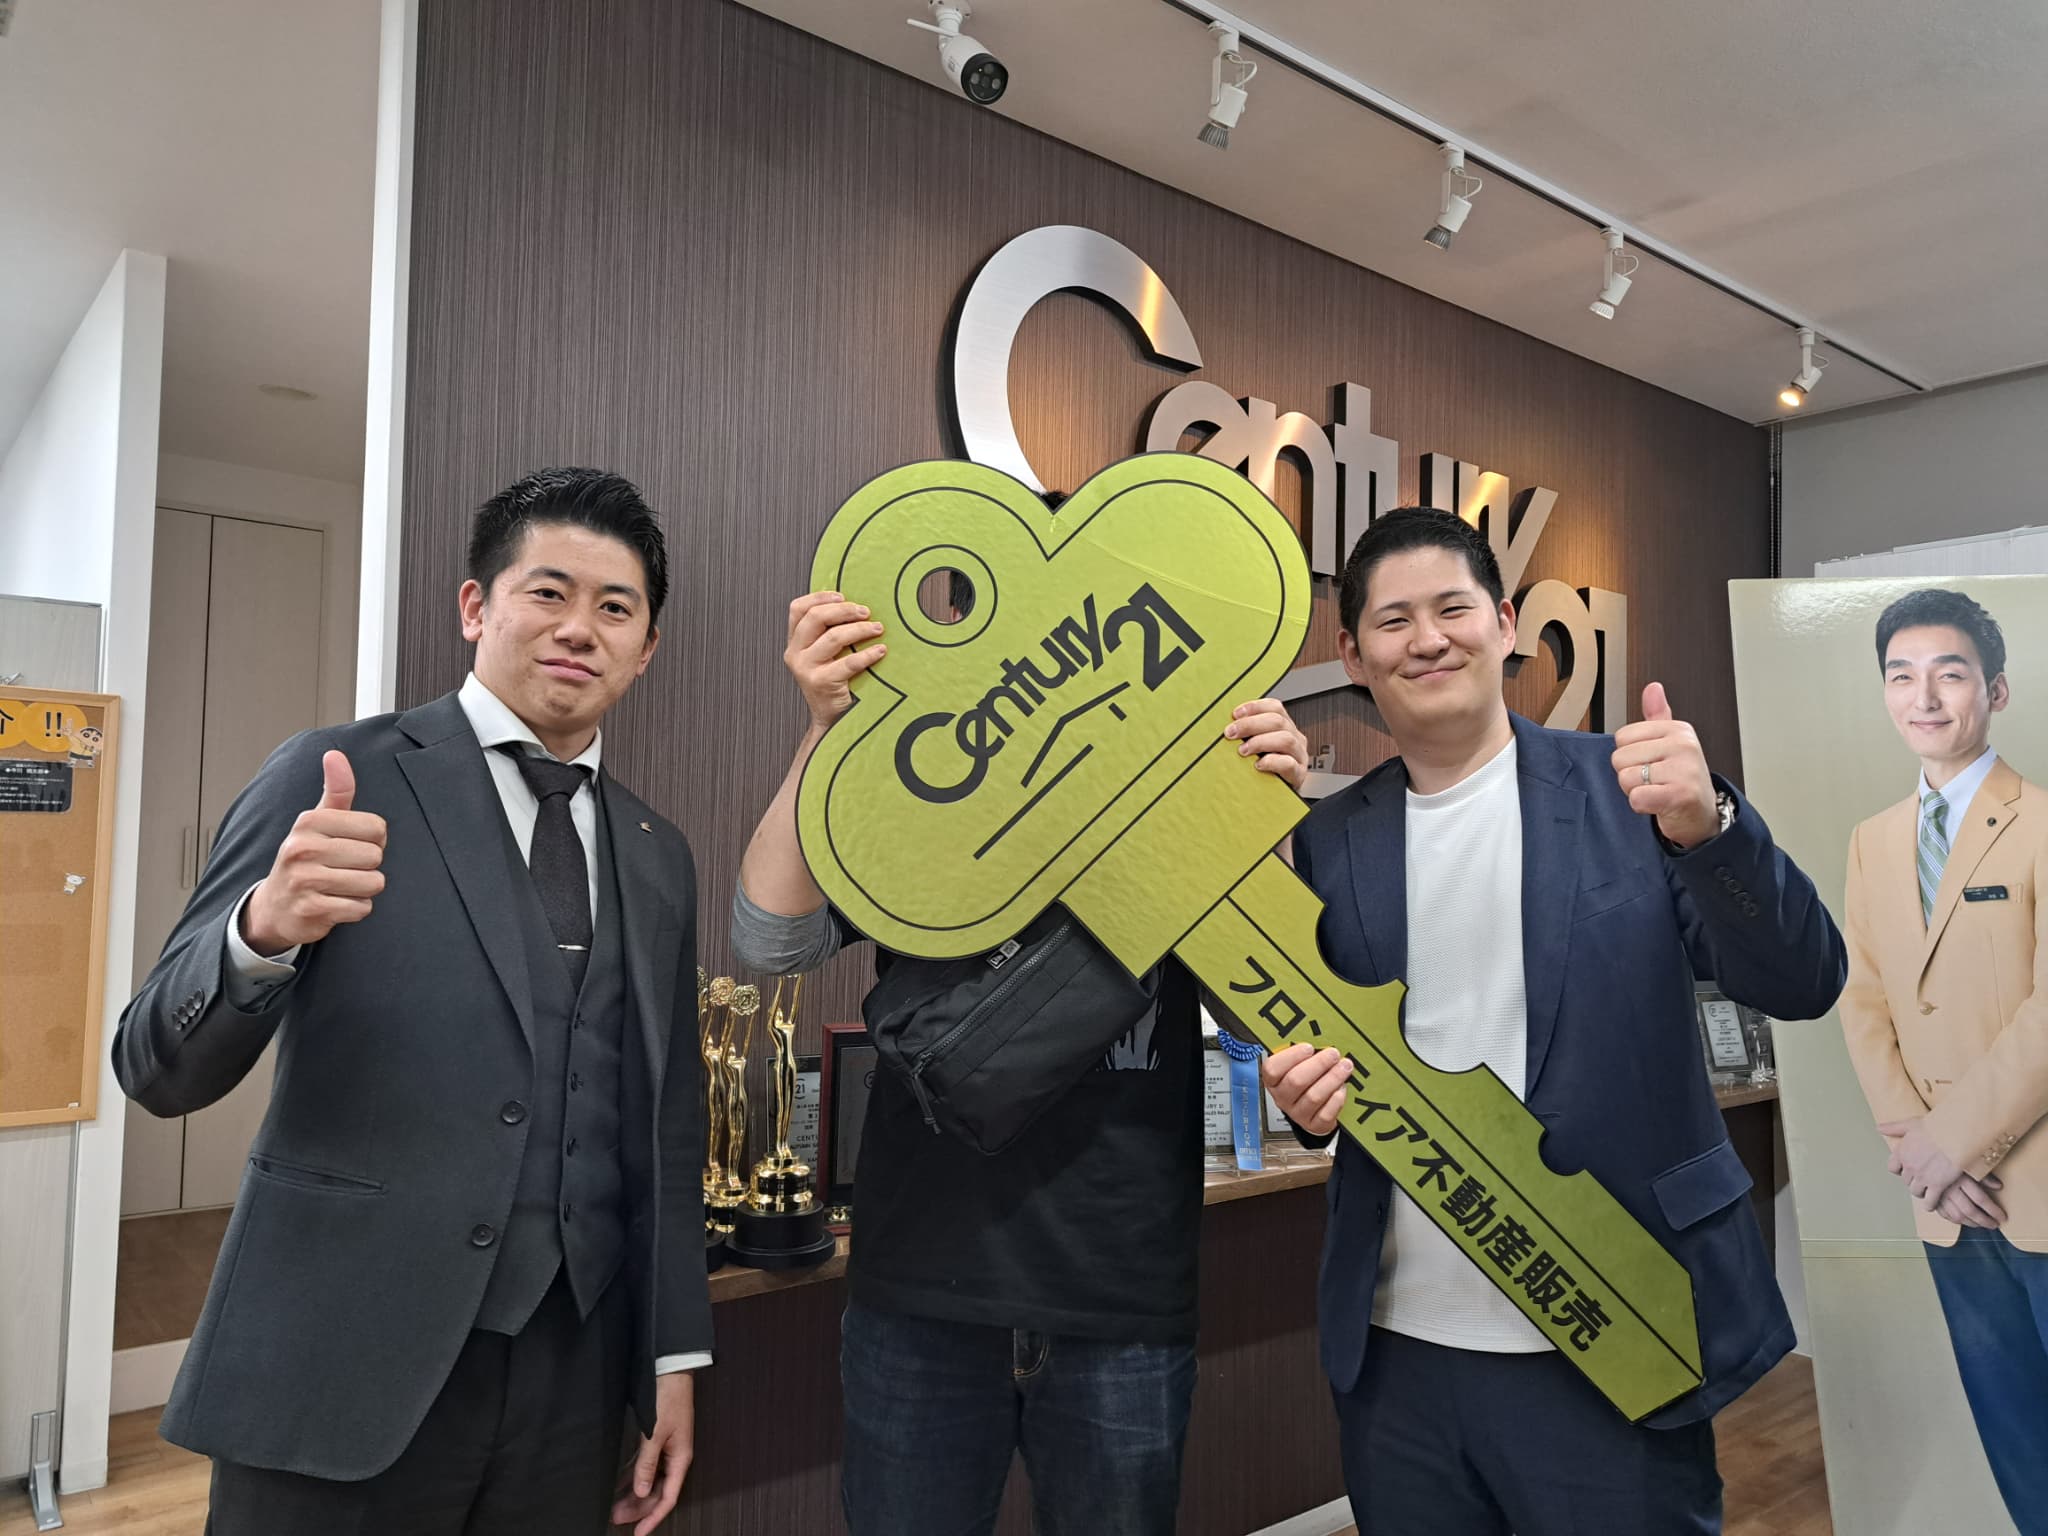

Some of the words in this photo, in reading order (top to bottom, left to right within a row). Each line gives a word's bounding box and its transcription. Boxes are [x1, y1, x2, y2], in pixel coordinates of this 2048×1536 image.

[894, 593, 1104, 804] Century
[1102, 581, 1206, 692] 21
[1513, 579, 1628, 735] 21
[1229, 955, 1613, 1352] フロティア不動産販売
